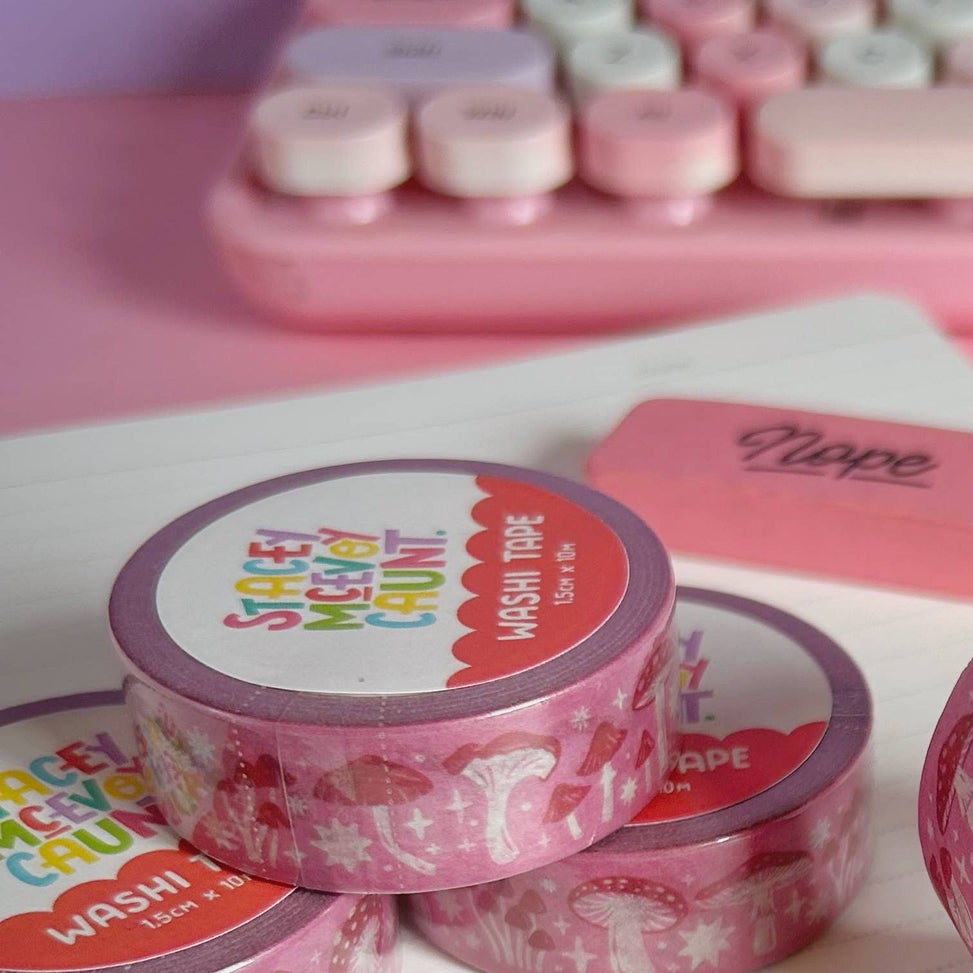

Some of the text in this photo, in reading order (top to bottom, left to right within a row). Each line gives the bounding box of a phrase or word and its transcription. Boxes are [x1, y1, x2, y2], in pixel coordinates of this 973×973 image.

[737, 425, 940, 481] Nope
[222, 528, 322, 631] STACEY
[364, 528, 449, 629] CAUNT.
[496, 514, 545, 641] WASHI TAPE
[0, 732, 128, 818] ACEY
[678, 746, 751, 774] APE
[6, 796, 169, 887] CAUN
[47, 869, 192, 945] WASHI
